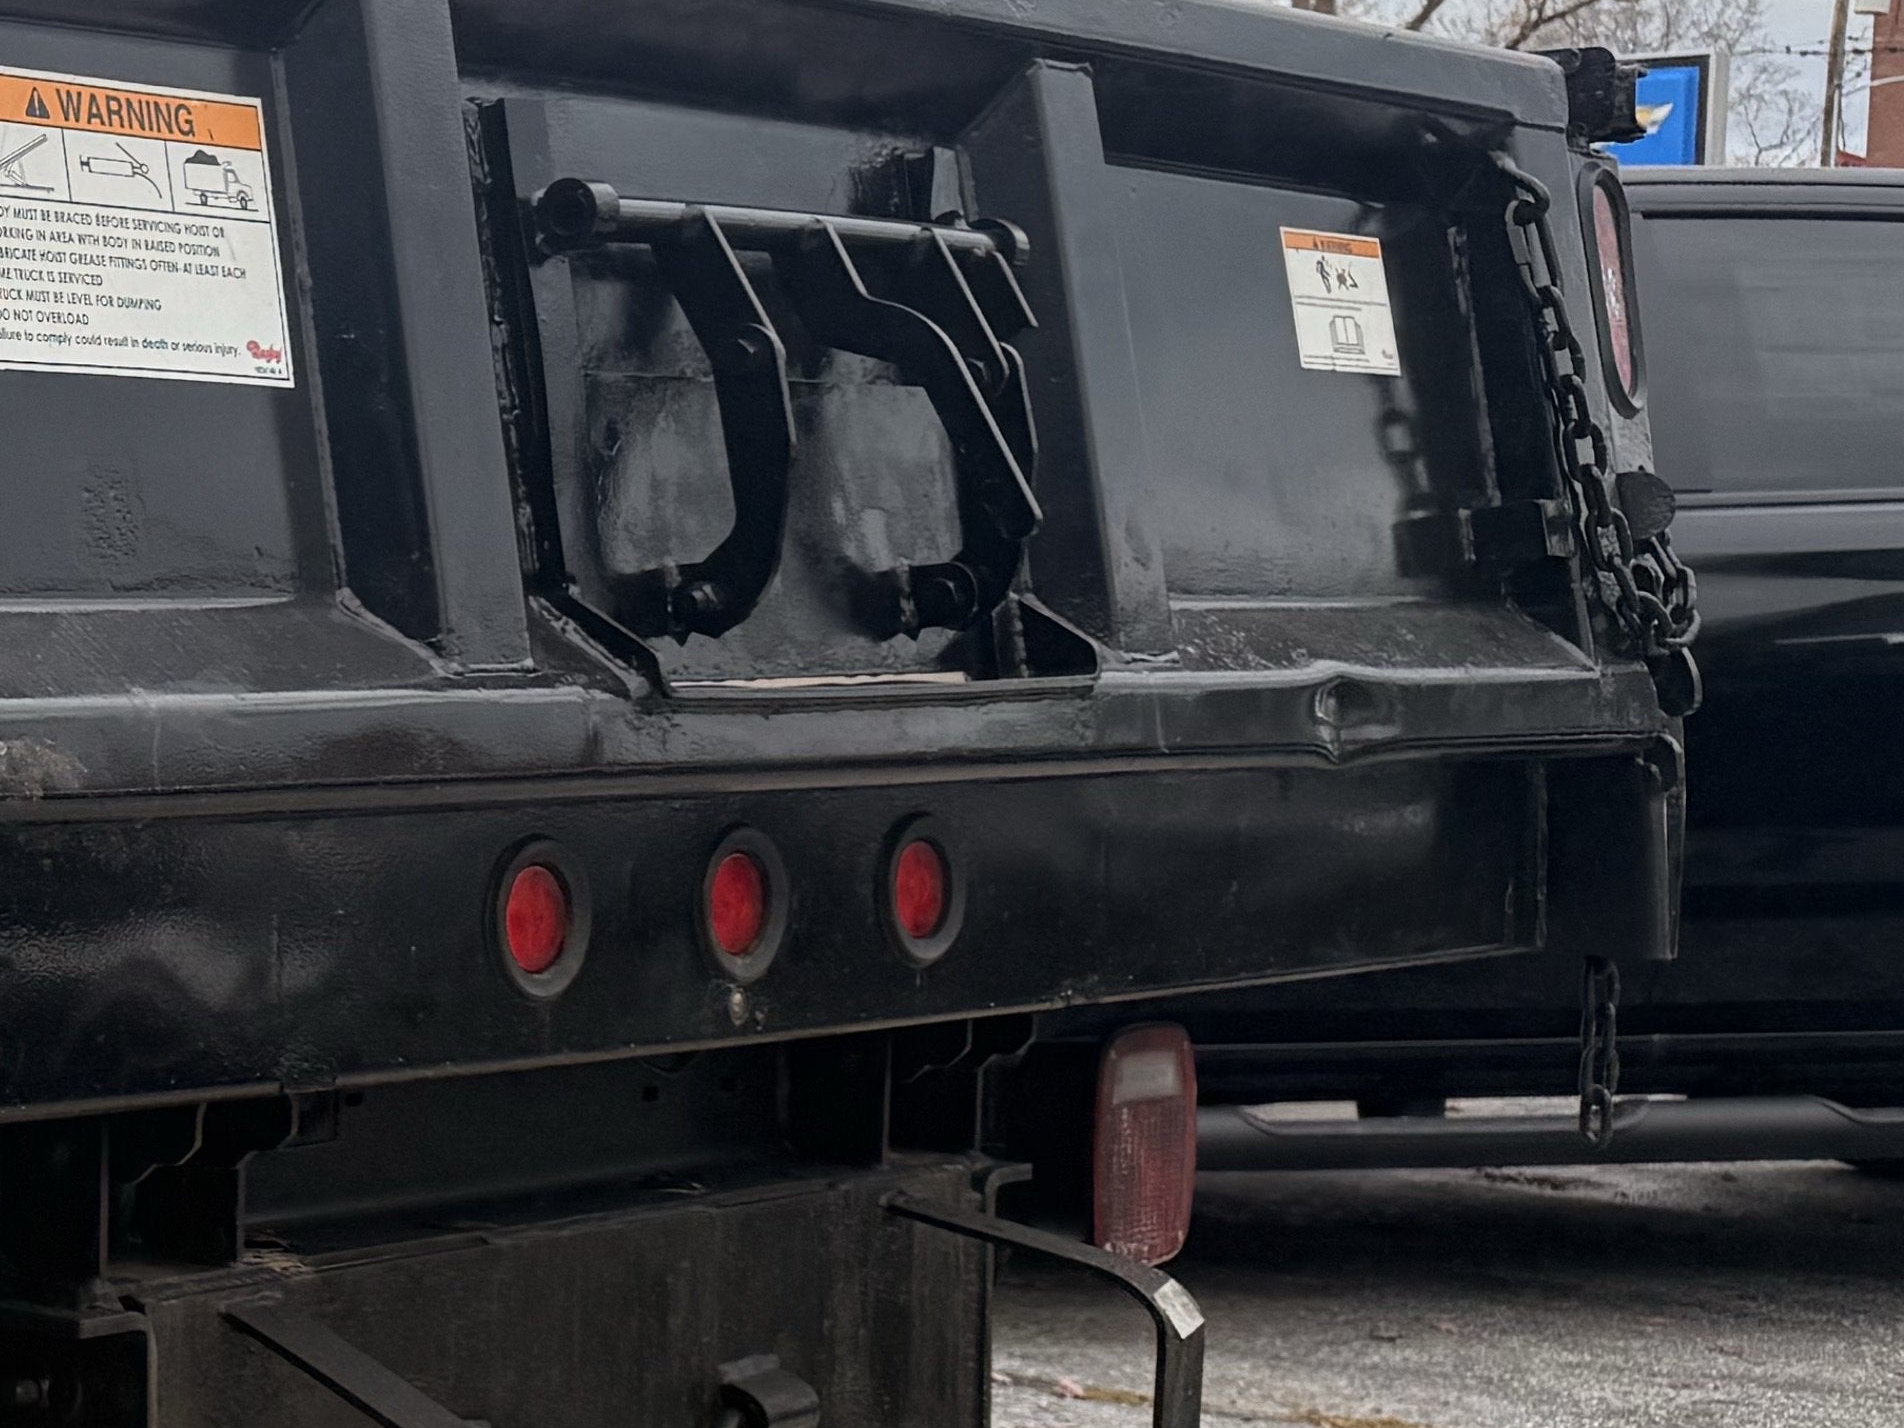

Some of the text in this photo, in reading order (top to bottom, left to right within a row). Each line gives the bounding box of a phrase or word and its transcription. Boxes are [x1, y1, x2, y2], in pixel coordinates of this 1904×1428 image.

[55, 88, 196, 137] WARNING
[13, 207, 38, 221] MUST
[40, 210, 51, 222] BE
[55, 211, 92, 225] BRACED
[95, 212, 130, 229] BEFORE
[132, 217, 181, 234] SERVICING
[36, 230, 46, 241] IN
[49, 232, 74, 244] AREA
[102, 236, 128, 248] BODY
[132, 239, 141, 250] IN
[145, 241, 175, 253] RAISED
[179, 243, 220, 257] POSITION
[39, 250, 66, 263] HOIST
[69, 252, 106, 267] GREASE
[109, 256, 147, 270] FITTINGS
[195, 263, 219, 277] LEAST
[222, 265, 246, 279] EACH
[14, 269, 43, 282] TRUCK
[58, 272, 103, 286] SERVICED
[26, 290, 51, 303] MUST
[53, 292, 64, 304] BE
[66, 293, 93, 306] LEVEL
[96, 295, 114, 307] FOR
[117, 297, 162, 311] DUMPING
[13, 309, 33, 321] NOT
[36, 312, 89, 325] OVERLOAD
[24, 331, 34, 341] to
[36, 332, 72, 346] comply
[75, 334, 101, 346] could
[104, 335, 129, 347] result
[131, 336, 139, 347] in
[142, 337, 168, 350] death
[170, 340, 181, 351] or
[182, 341, 213, 354] serious
